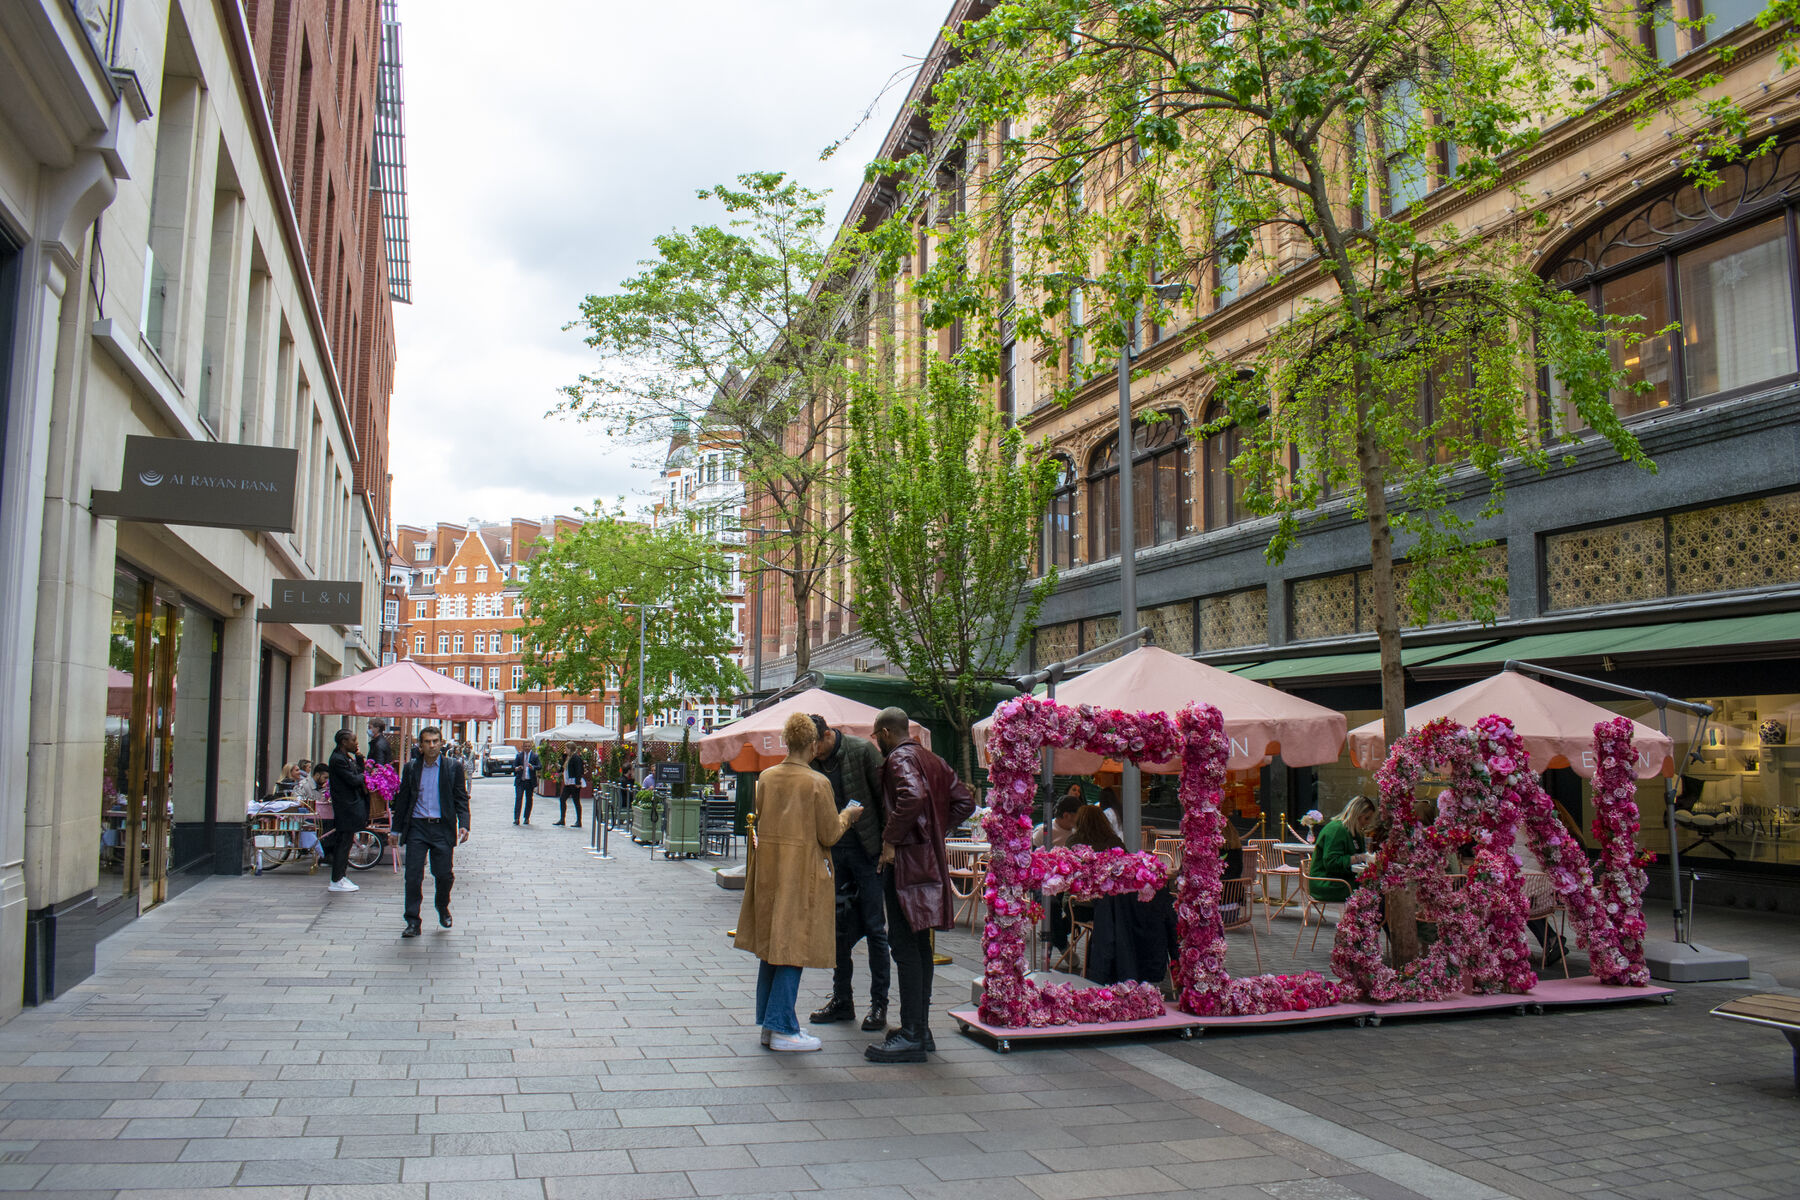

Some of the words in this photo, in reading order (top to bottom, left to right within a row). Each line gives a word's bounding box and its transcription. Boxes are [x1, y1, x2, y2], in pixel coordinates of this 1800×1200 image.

[191, 474, 236, 489] RAYAN
[240, 479, 278, 492] BANK
[763, 735, 788, 750] EL
